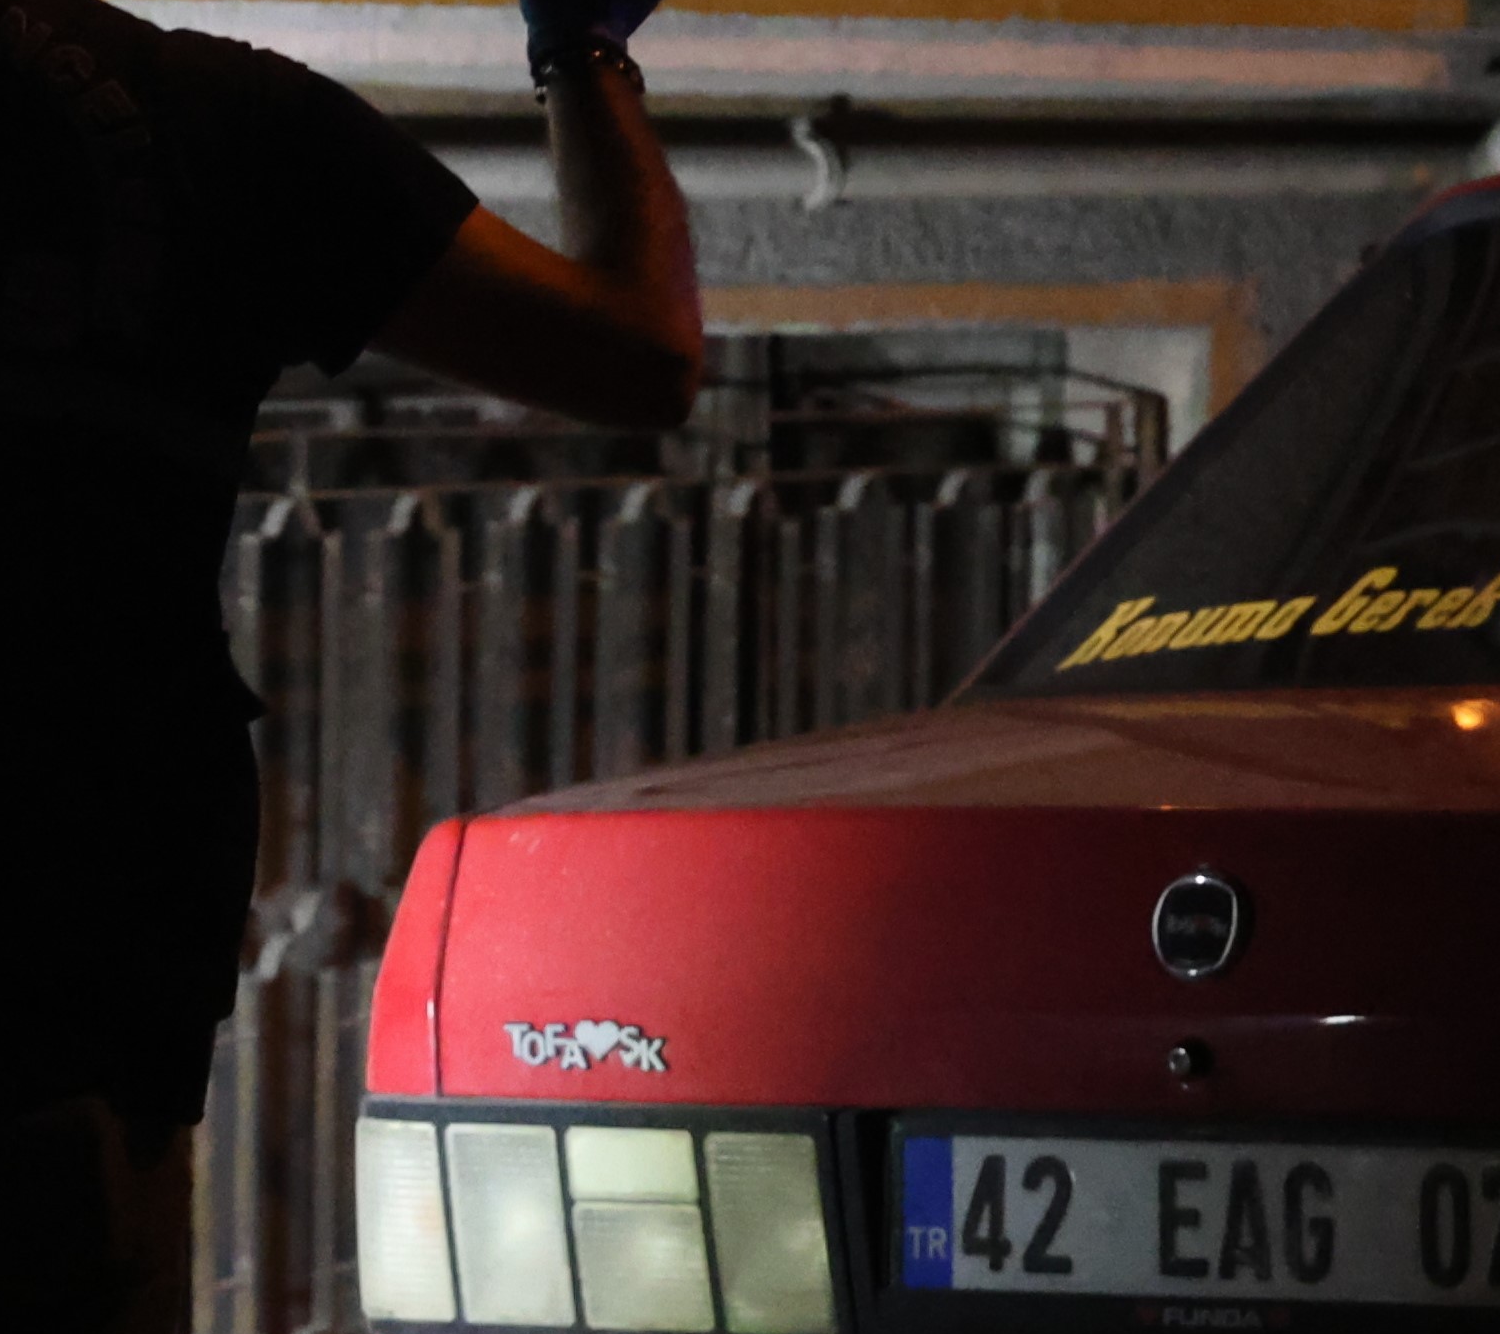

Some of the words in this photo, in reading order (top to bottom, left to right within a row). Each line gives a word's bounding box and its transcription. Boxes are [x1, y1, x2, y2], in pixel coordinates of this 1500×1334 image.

[908, 1225, 947, 1260] TR
[961, 1153, 1076, 1276] 42
[1156, 1158, 1336, 1284] EAG
